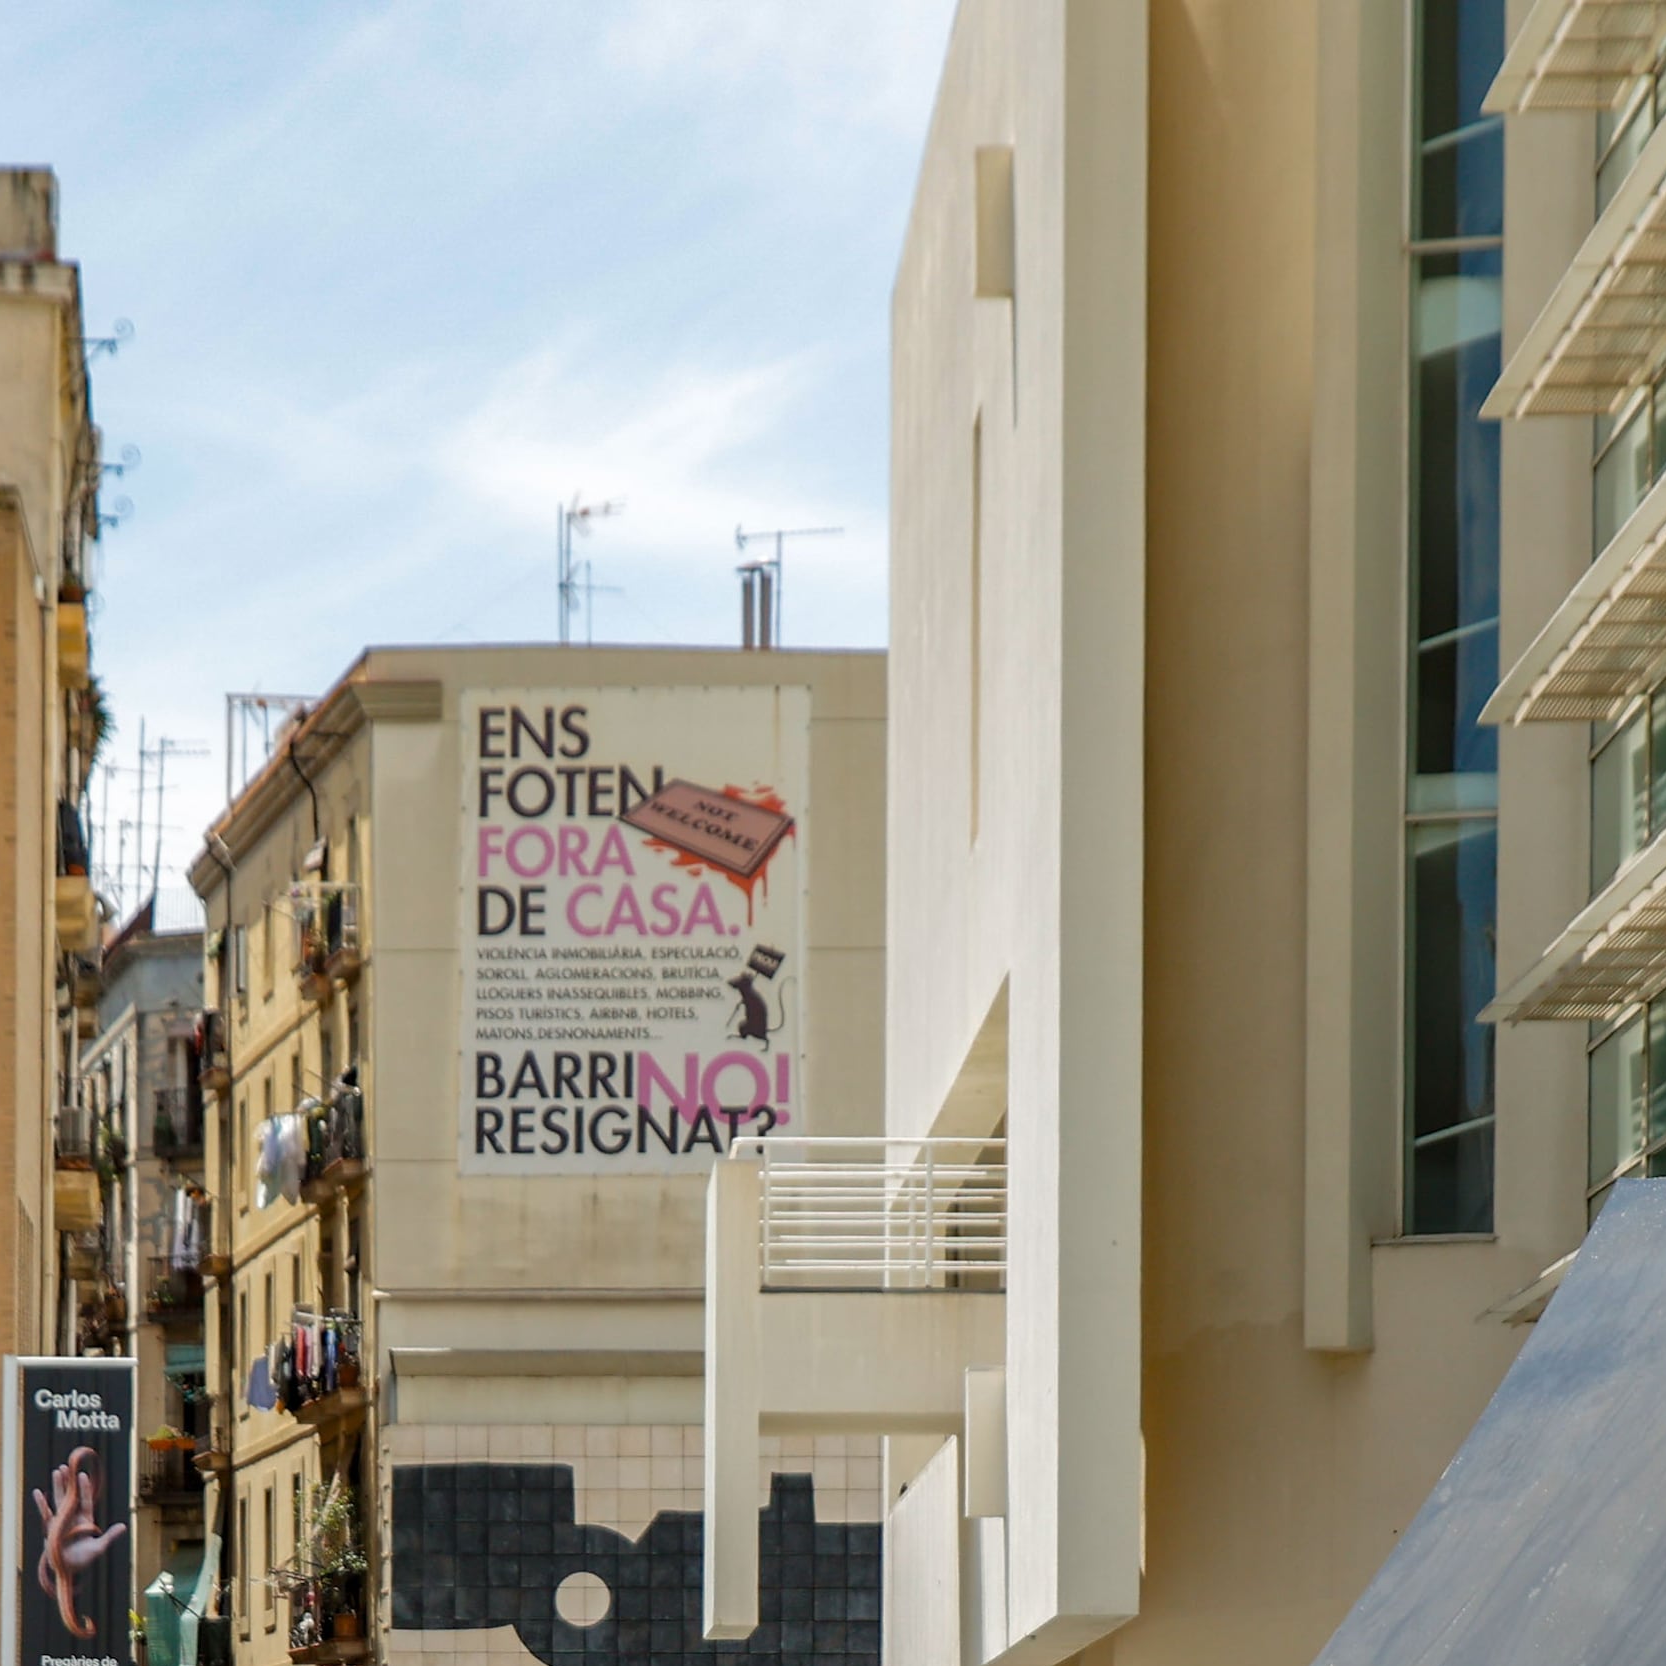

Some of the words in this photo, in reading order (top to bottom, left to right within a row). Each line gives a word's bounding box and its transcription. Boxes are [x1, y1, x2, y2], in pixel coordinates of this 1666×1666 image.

[478, 705, 590, 759] ENS
[478, 764, 664, 819] FOTEN
[695, 799, 738, 821] NOT
[477, 824, 636, 878] FORA
[651, 801, 759, 852] WELCOME
[477, 885, 547, 937] DE
[565, 882, 741, 938] CASA.
[476, 986, 543, 1000] LLOGUERS
[476, 1006, 515, 1020] PISOS
[646, 1006, 699, 1021] HOTELS,
[475, 1050, 633, 1099] BARRI
[637, 1050, 791, 1126] NO!
[475, 1104, 776, 1155] RESIGNAT?
[34, 1388, 102, 1409] Carlos
[57, 1409, 120, 1430] Motta
